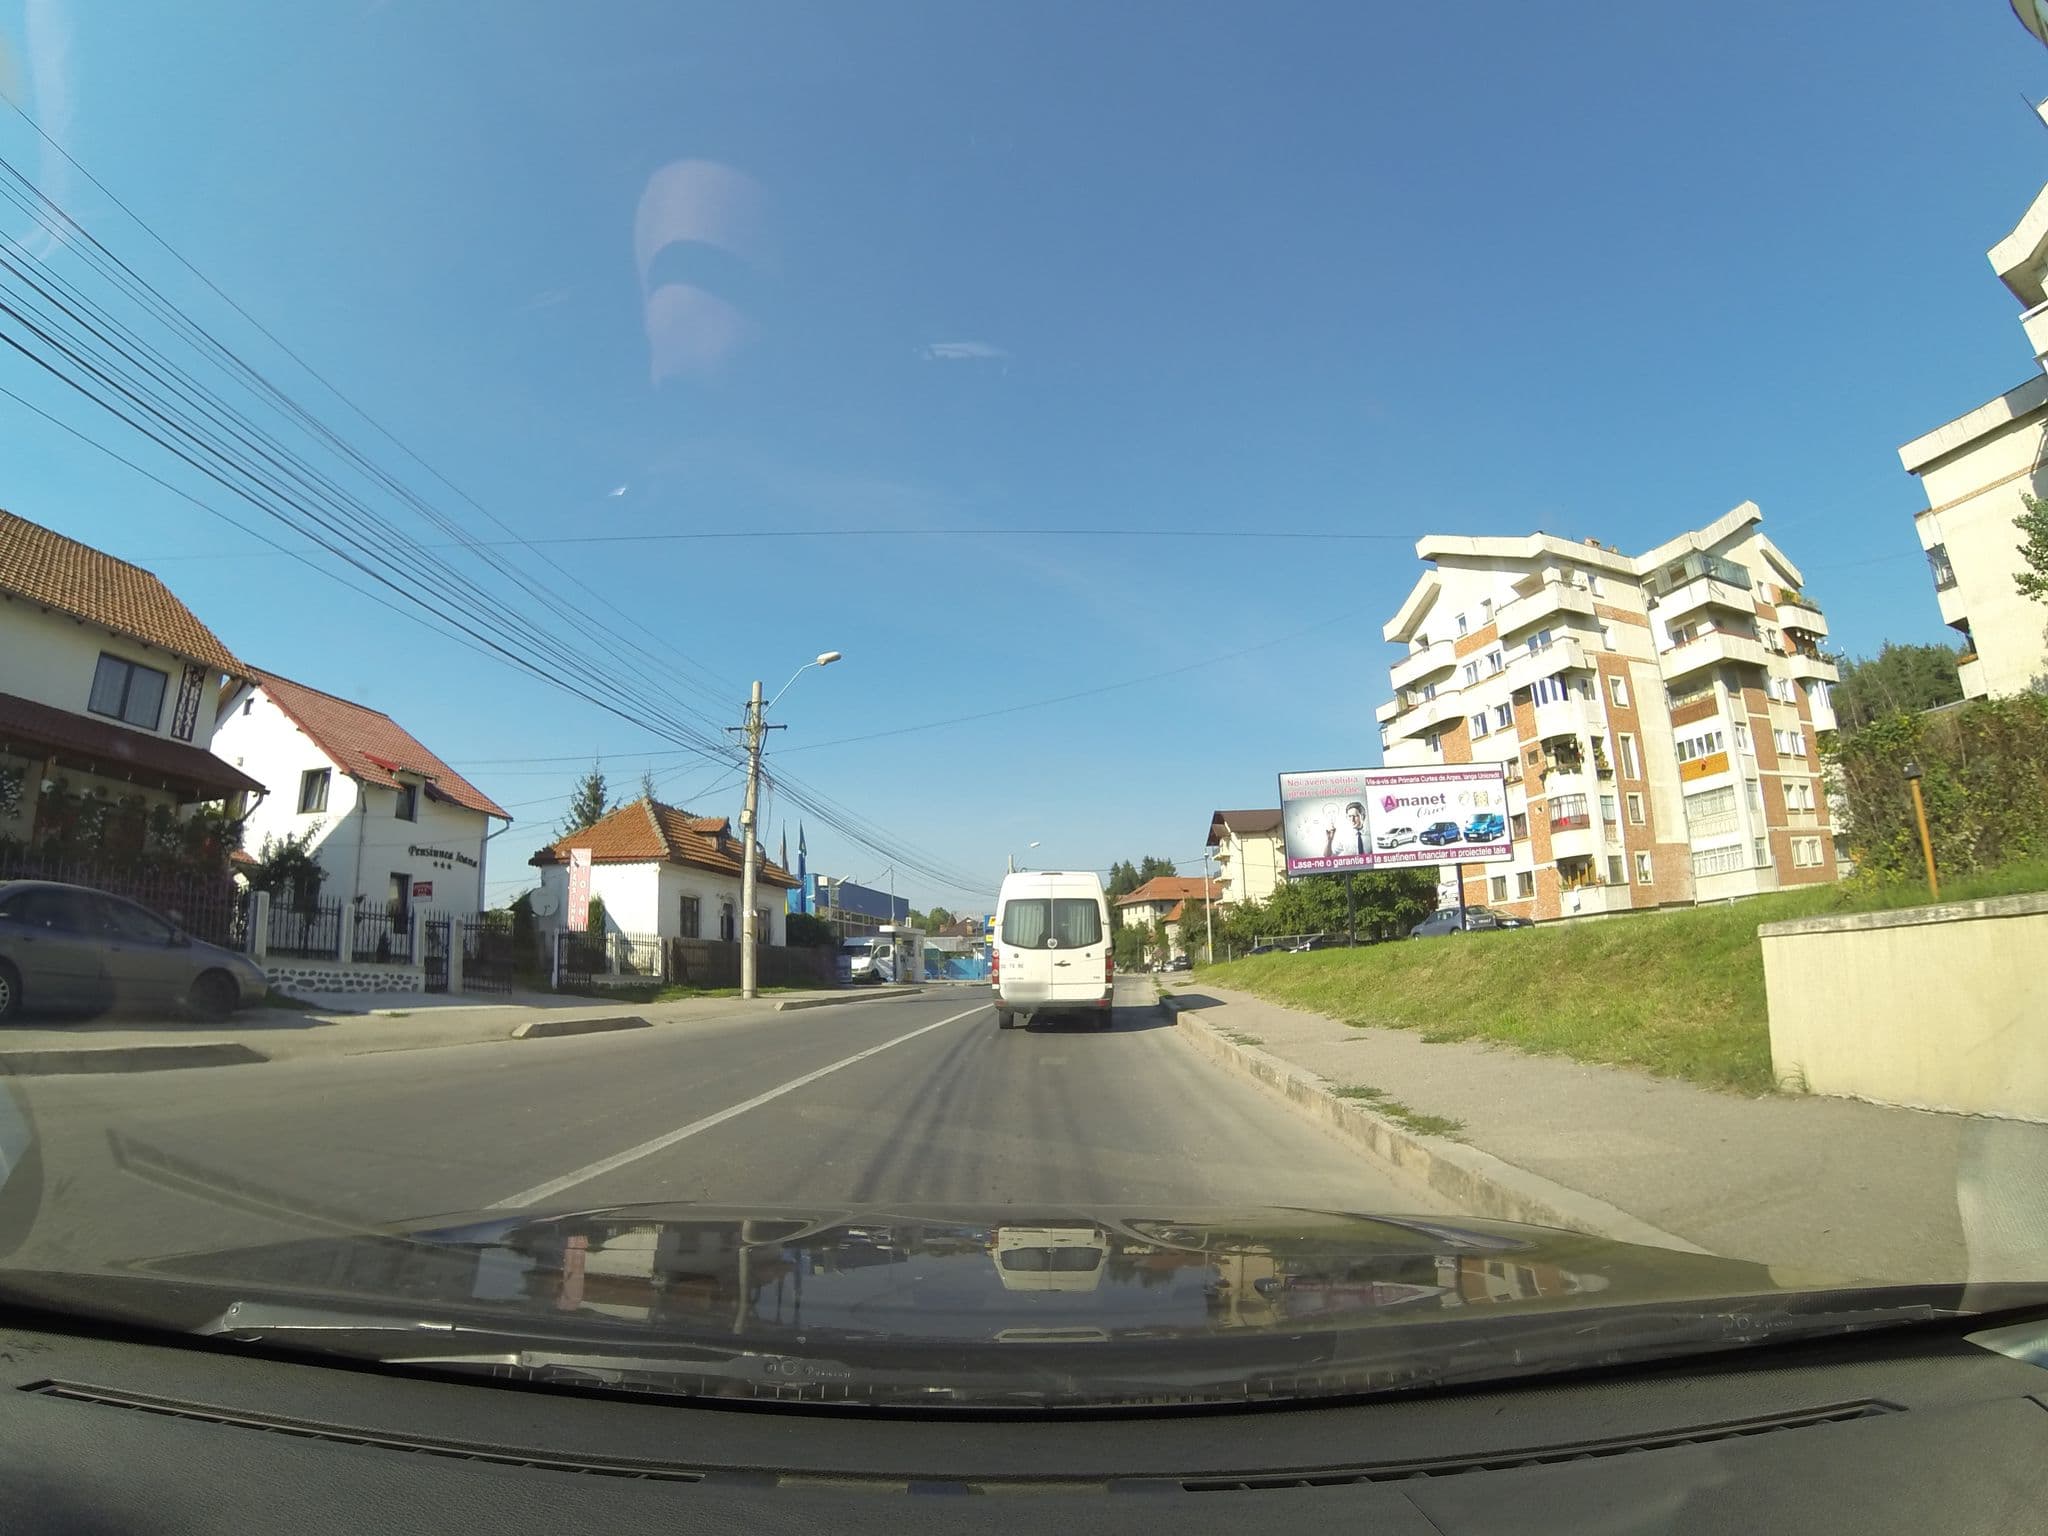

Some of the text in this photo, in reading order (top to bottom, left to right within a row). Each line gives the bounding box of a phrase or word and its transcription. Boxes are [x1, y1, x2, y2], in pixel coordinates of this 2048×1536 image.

[1384, 793, 1446, 808] Amanet
[408, 845, 454, 860] Pensiunea
[1292, 860, 1325, 869] Lasa-ne
[1333, 857, 1364, 868] garantie
[1418, 850, 1448, 860] financiar
